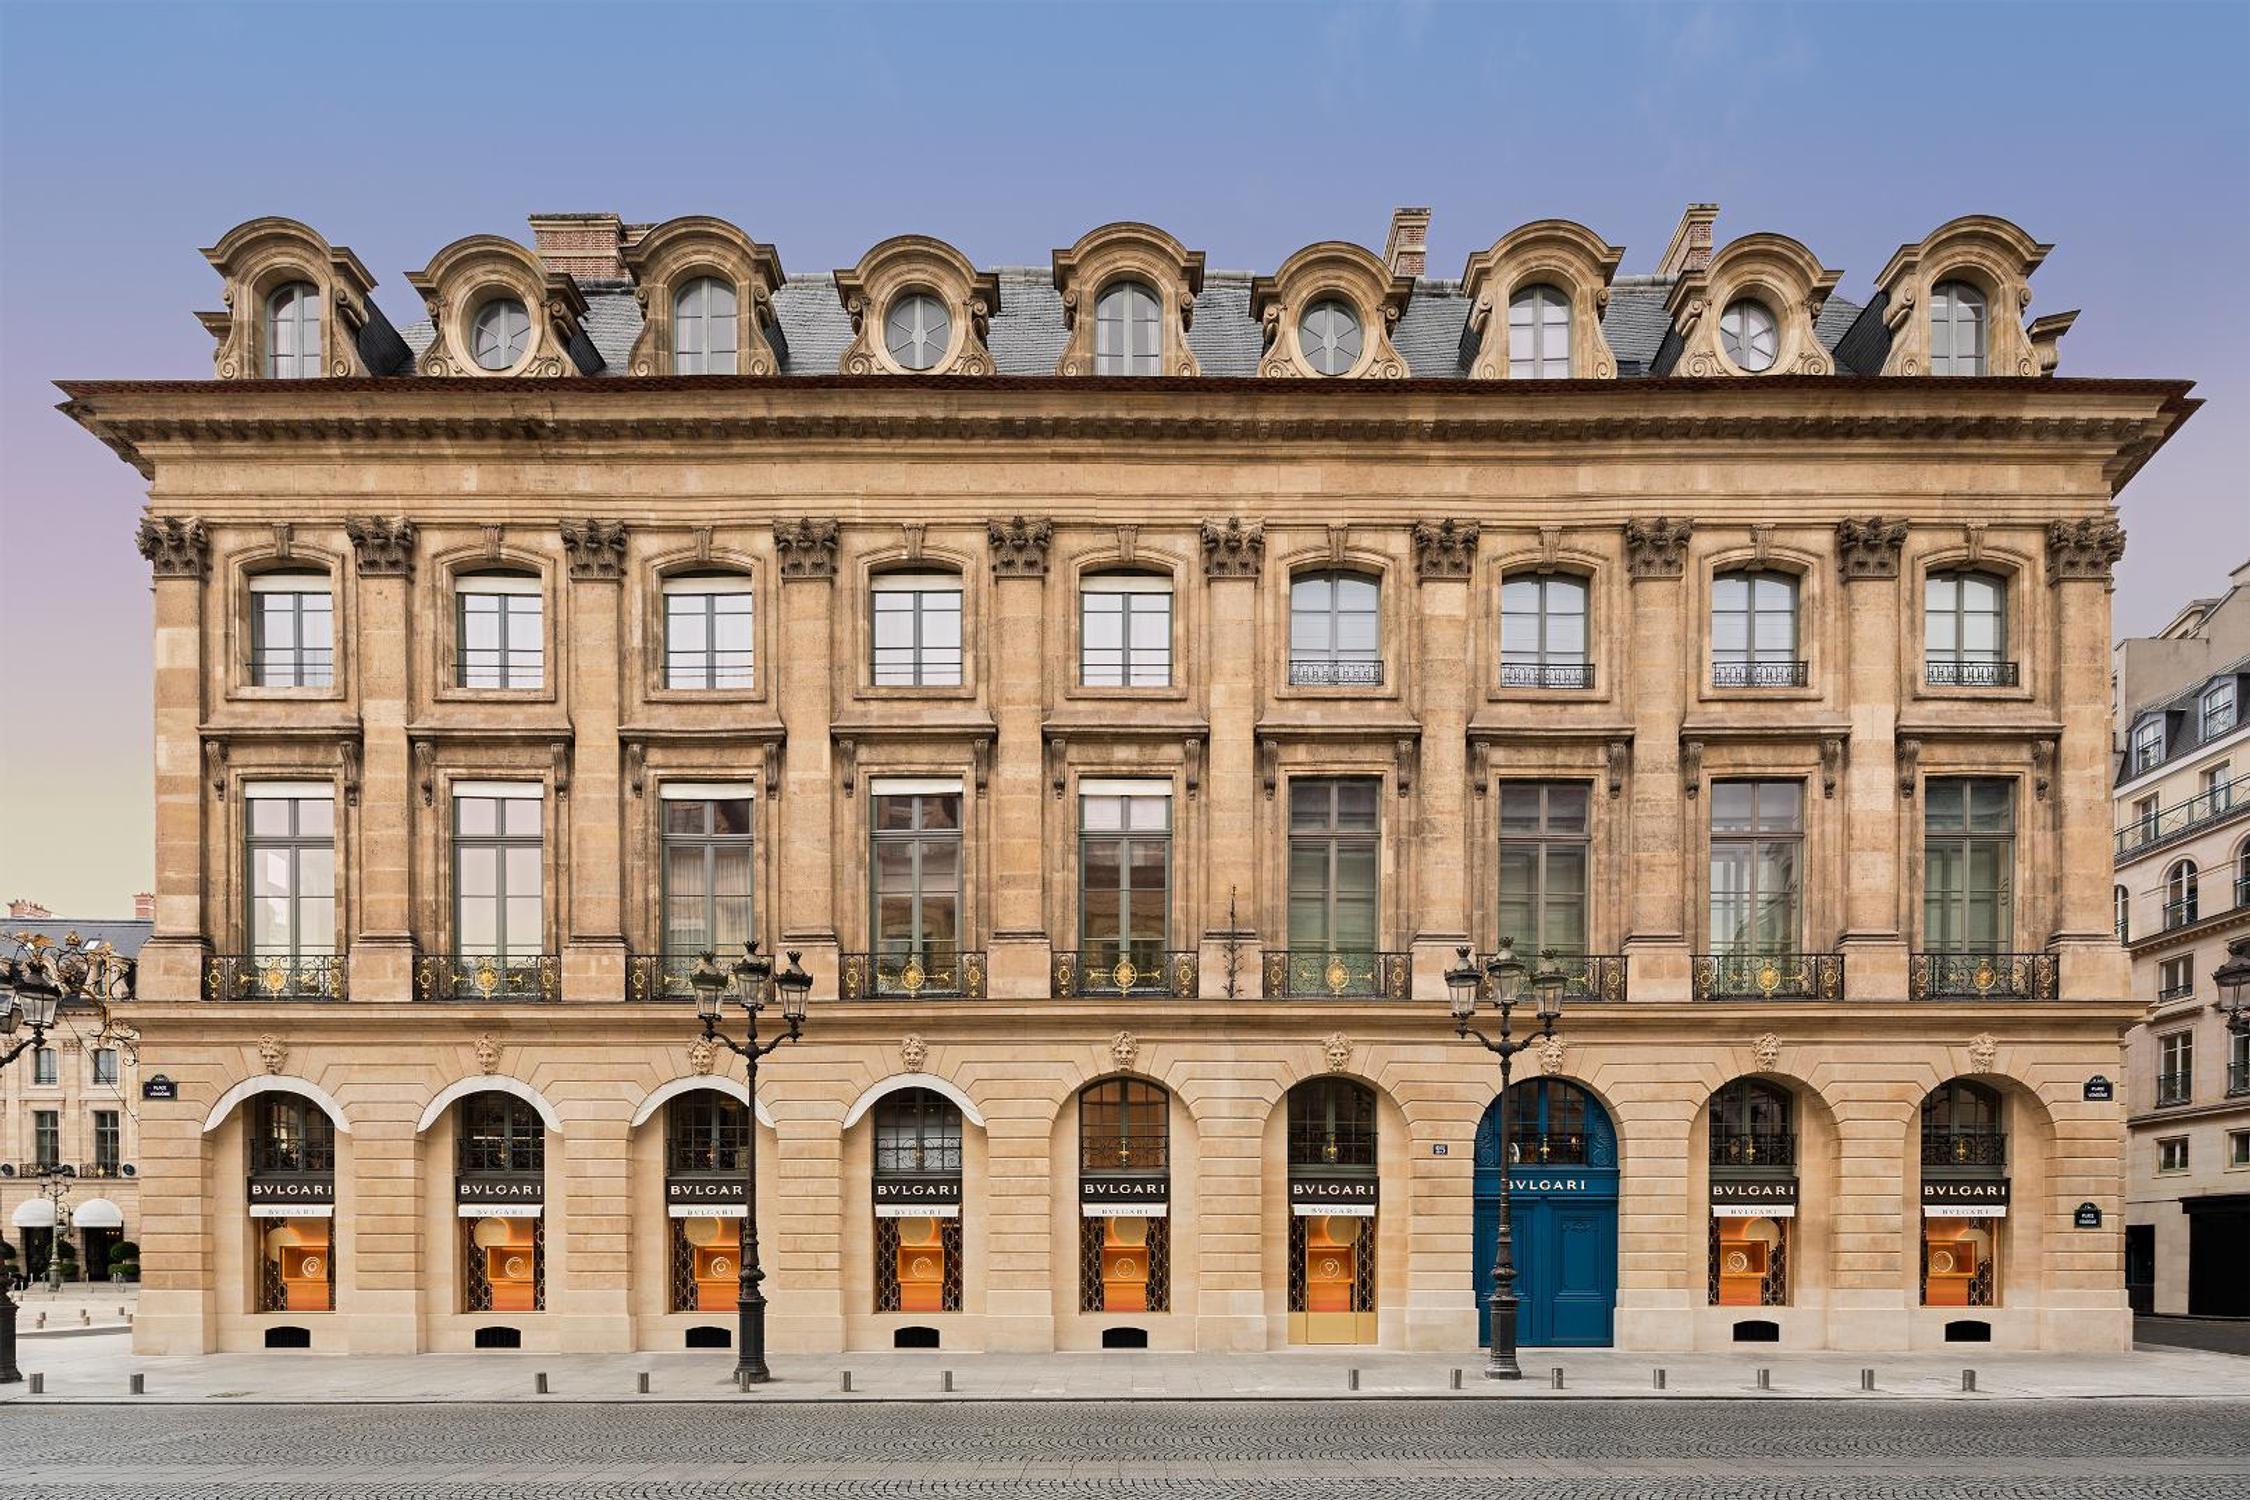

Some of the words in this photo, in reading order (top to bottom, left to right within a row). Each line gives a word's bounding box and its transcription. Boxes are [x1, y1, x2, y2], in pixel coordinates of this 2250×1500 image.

[252, 1184, 332, 1195] BVLGARI
[460, 1184, 541, 1195] BVLGARI
[670, 1185, 743, 1195] BVLGAR
[877, 1185, 958, 1195] BVLGARI
[1084, 1184, 1165, 1194] BVLGARI
[1293, 1184, 1374, 1195] BVLGARI
[1713, 1185, 1794, 1196] BVLGARI
[1924, 1185, 2005, 1196] BVLGARI
